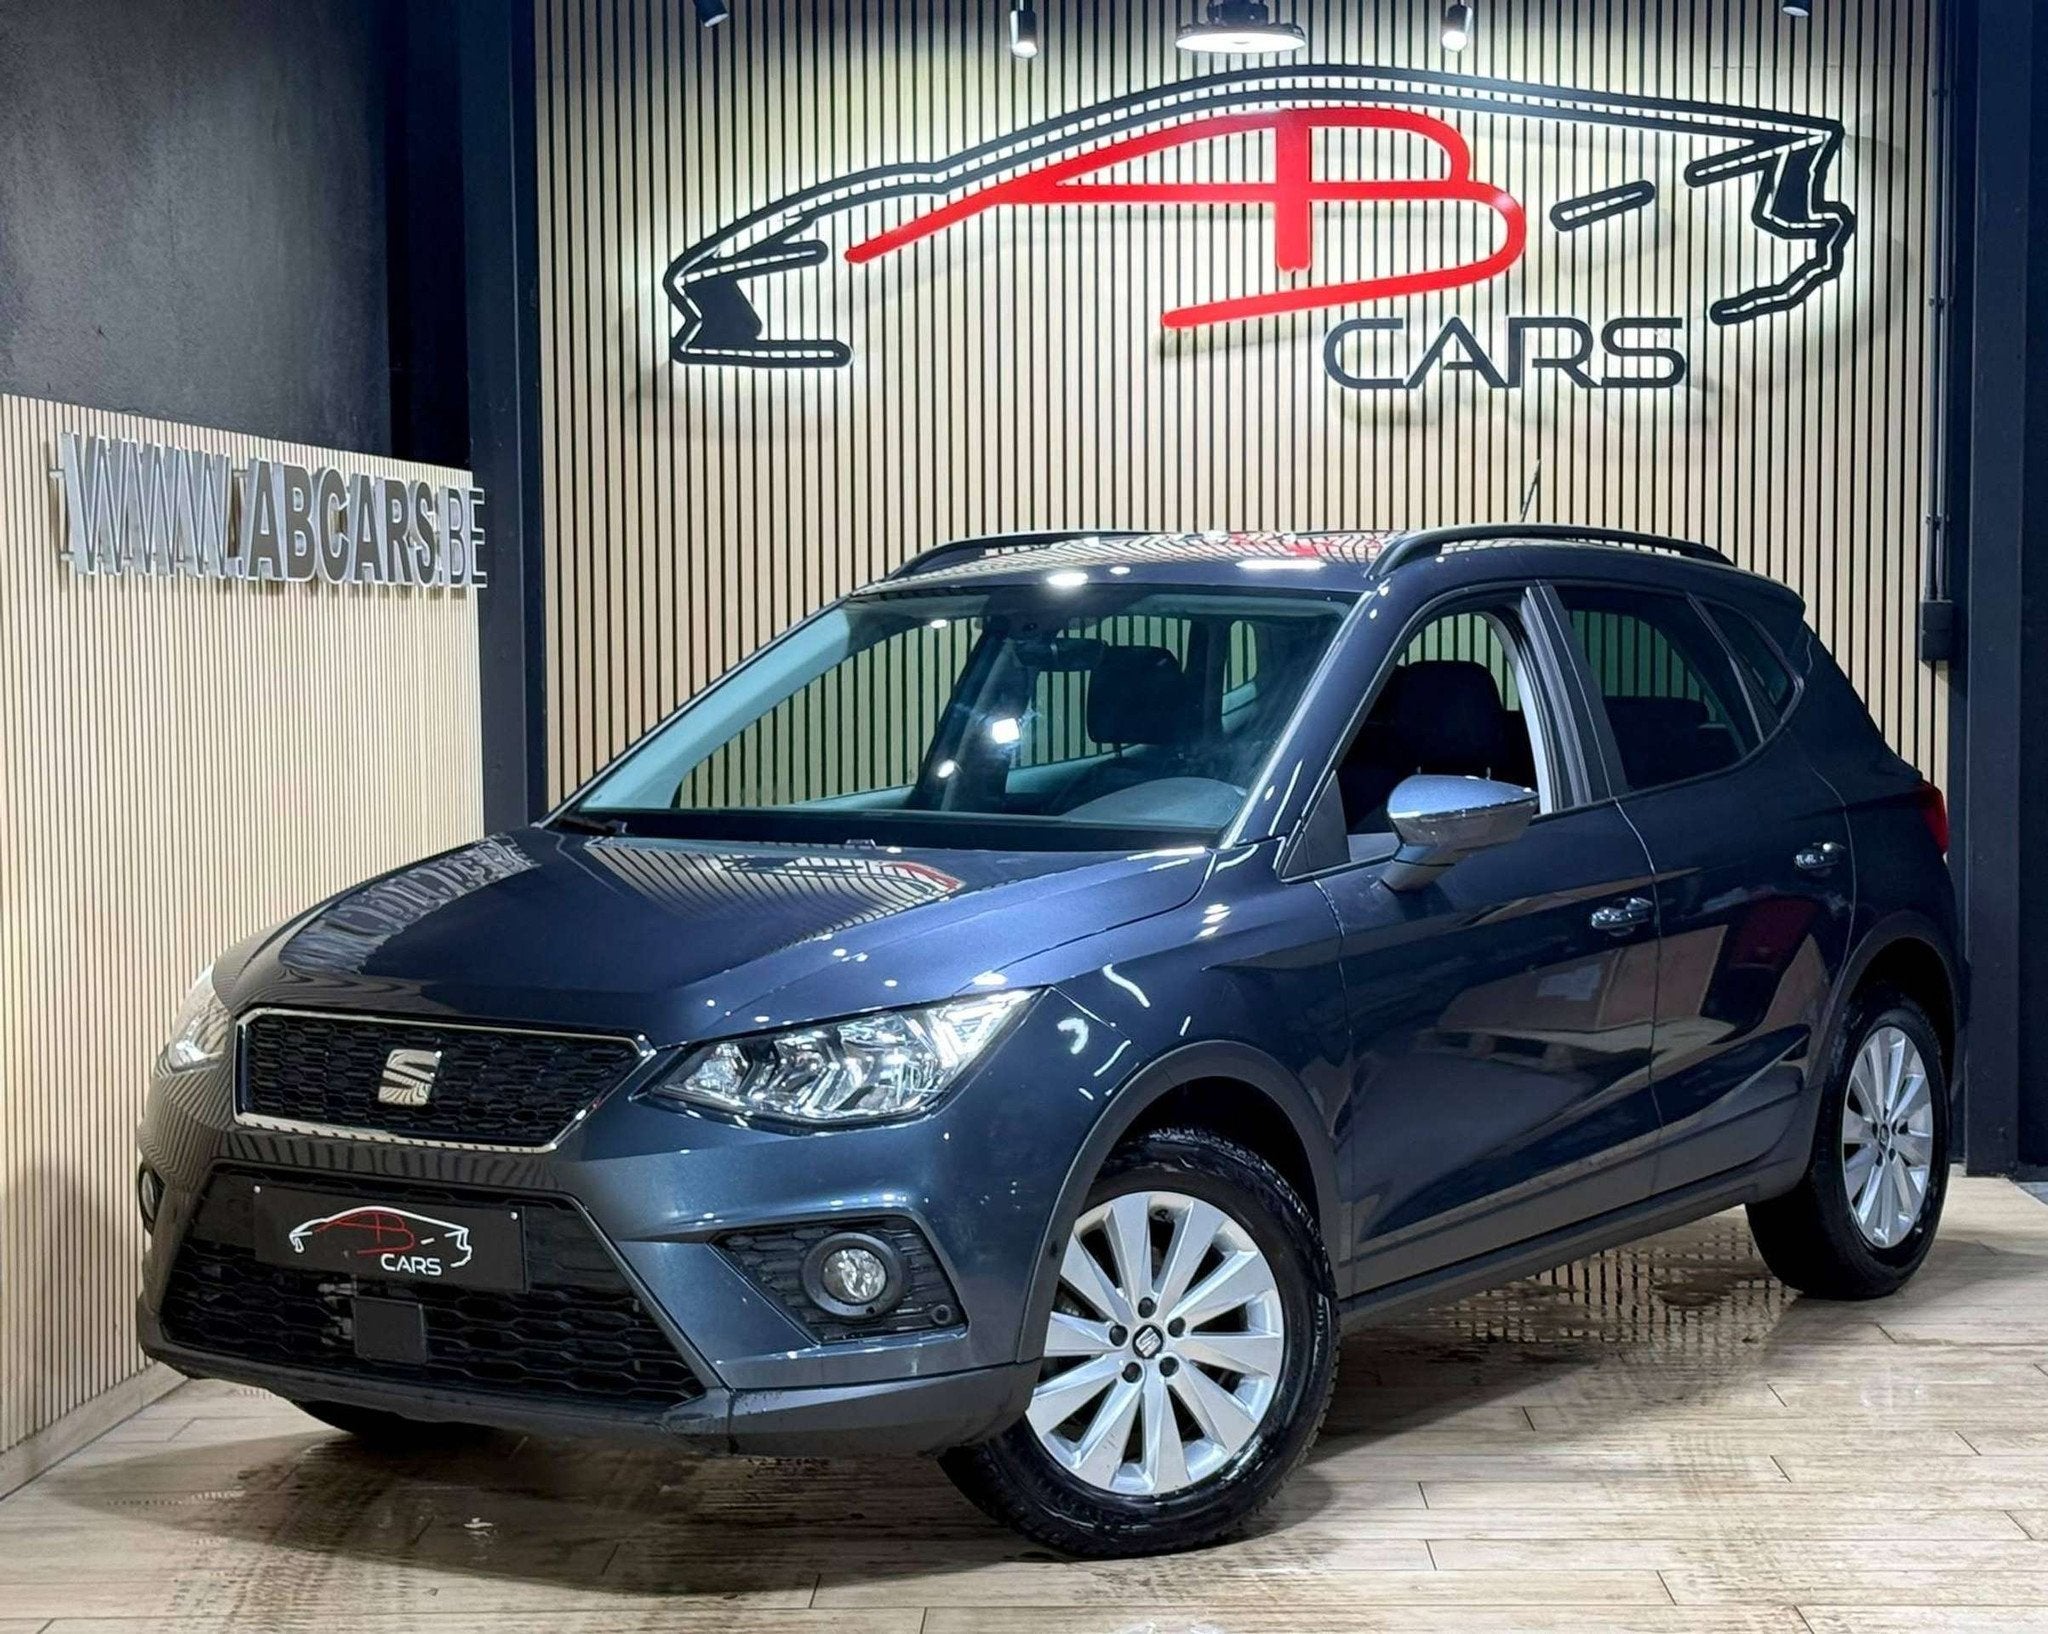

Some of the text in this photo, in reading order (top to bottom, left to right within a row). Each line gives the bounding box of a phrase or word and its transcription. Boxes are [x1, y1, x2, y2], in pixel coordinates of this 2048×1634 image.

[1323, 316, 1686, 389] CARS
[60, 432, 488, 588] WWW.ABCARS.BE
[380, 1253, 442, 1276] CARS
